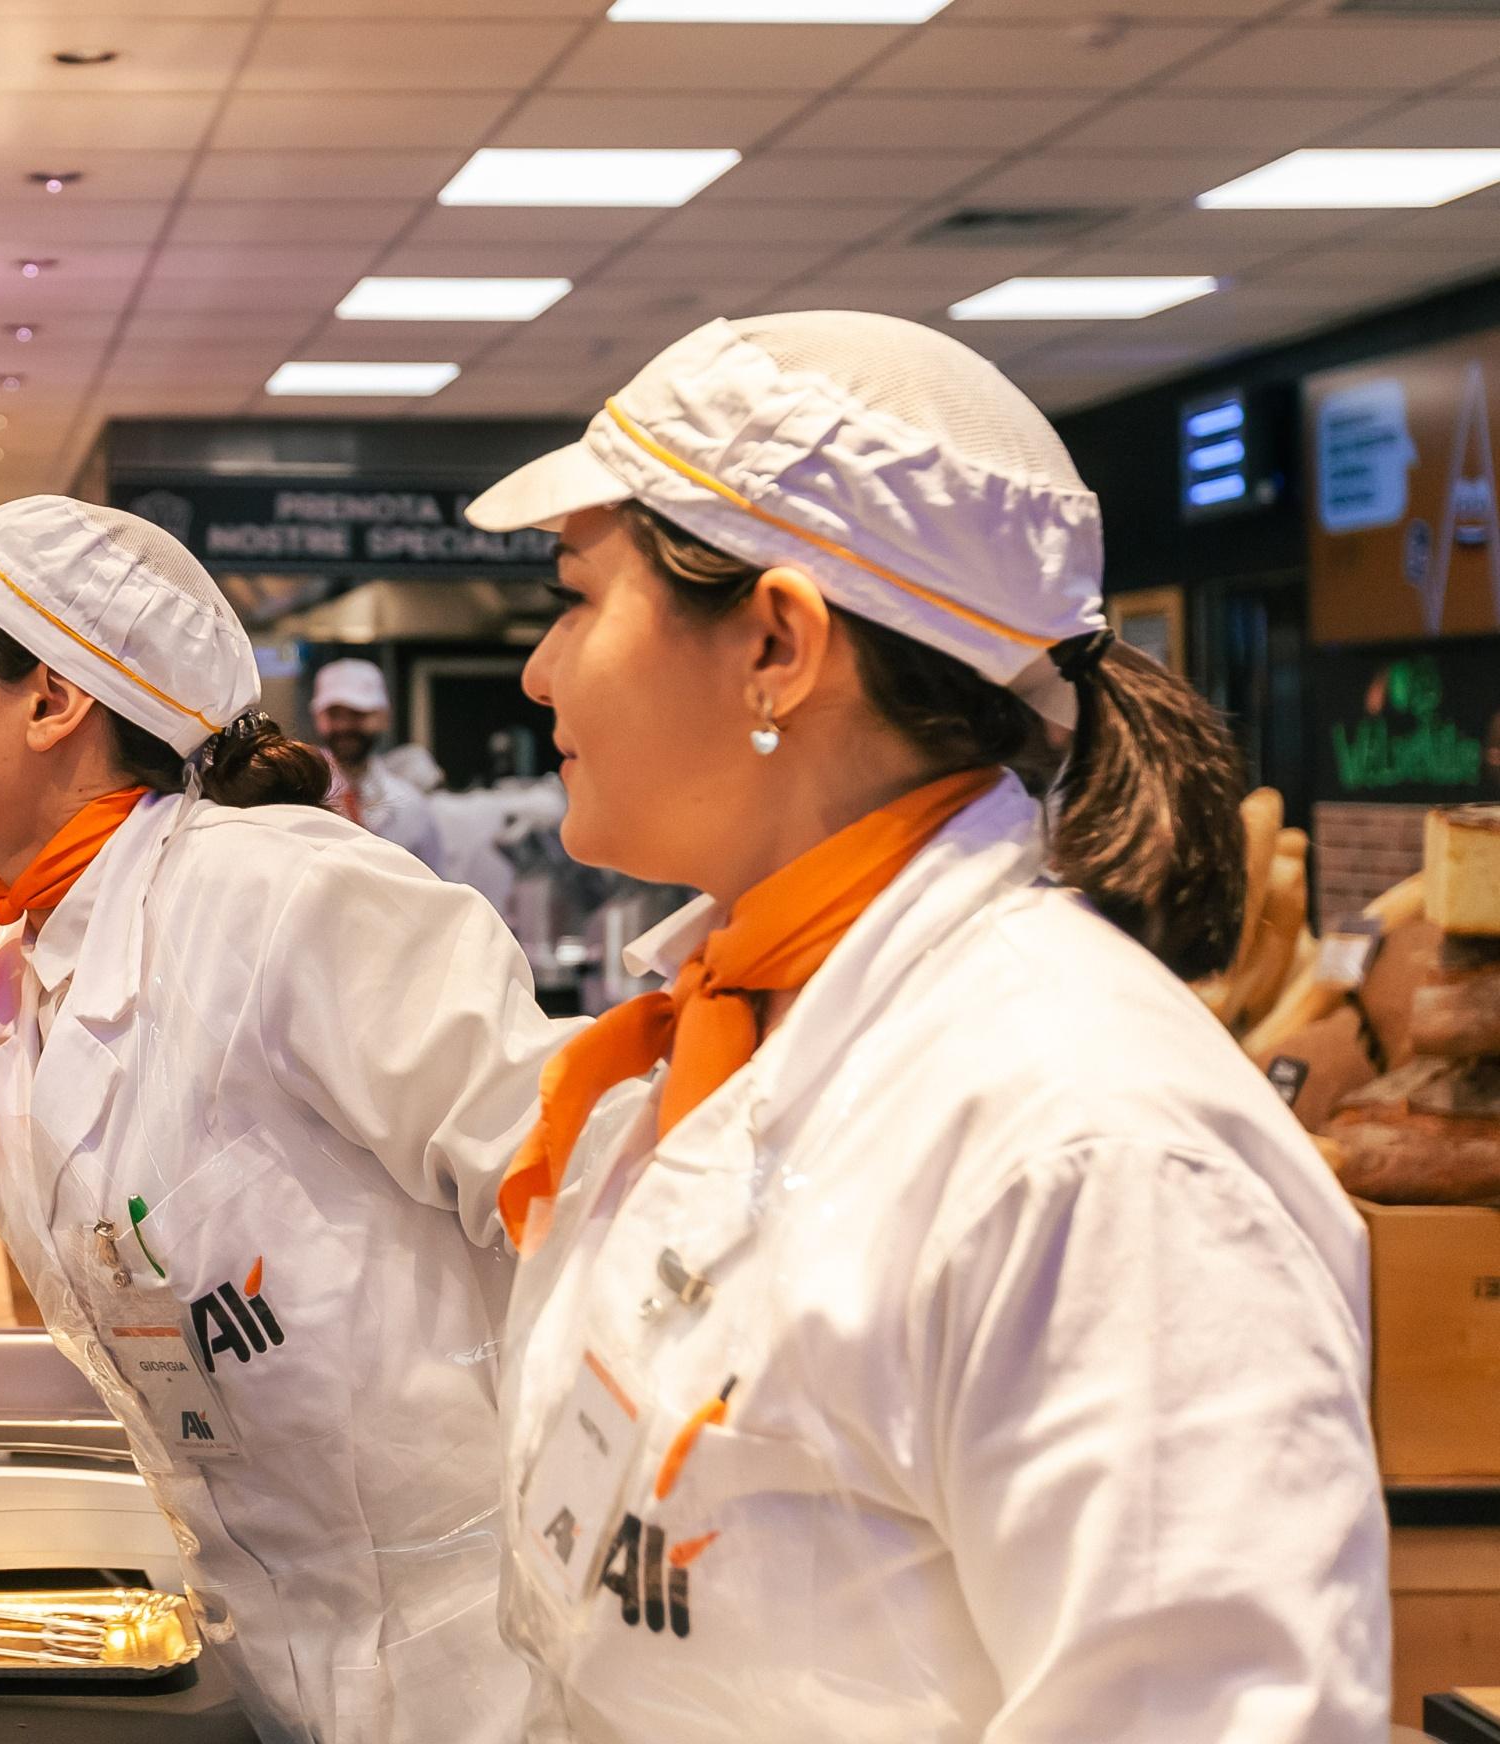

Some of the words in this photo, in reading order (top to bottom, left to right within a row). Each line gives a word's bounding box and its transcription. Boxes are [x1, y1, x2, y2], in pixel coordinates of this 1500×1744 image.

[276, 491, 442, 522] PRENOTA
[206, 524, 349, 557] NOSTRE
[139, 1360, 189, 1373] GIORGIA
